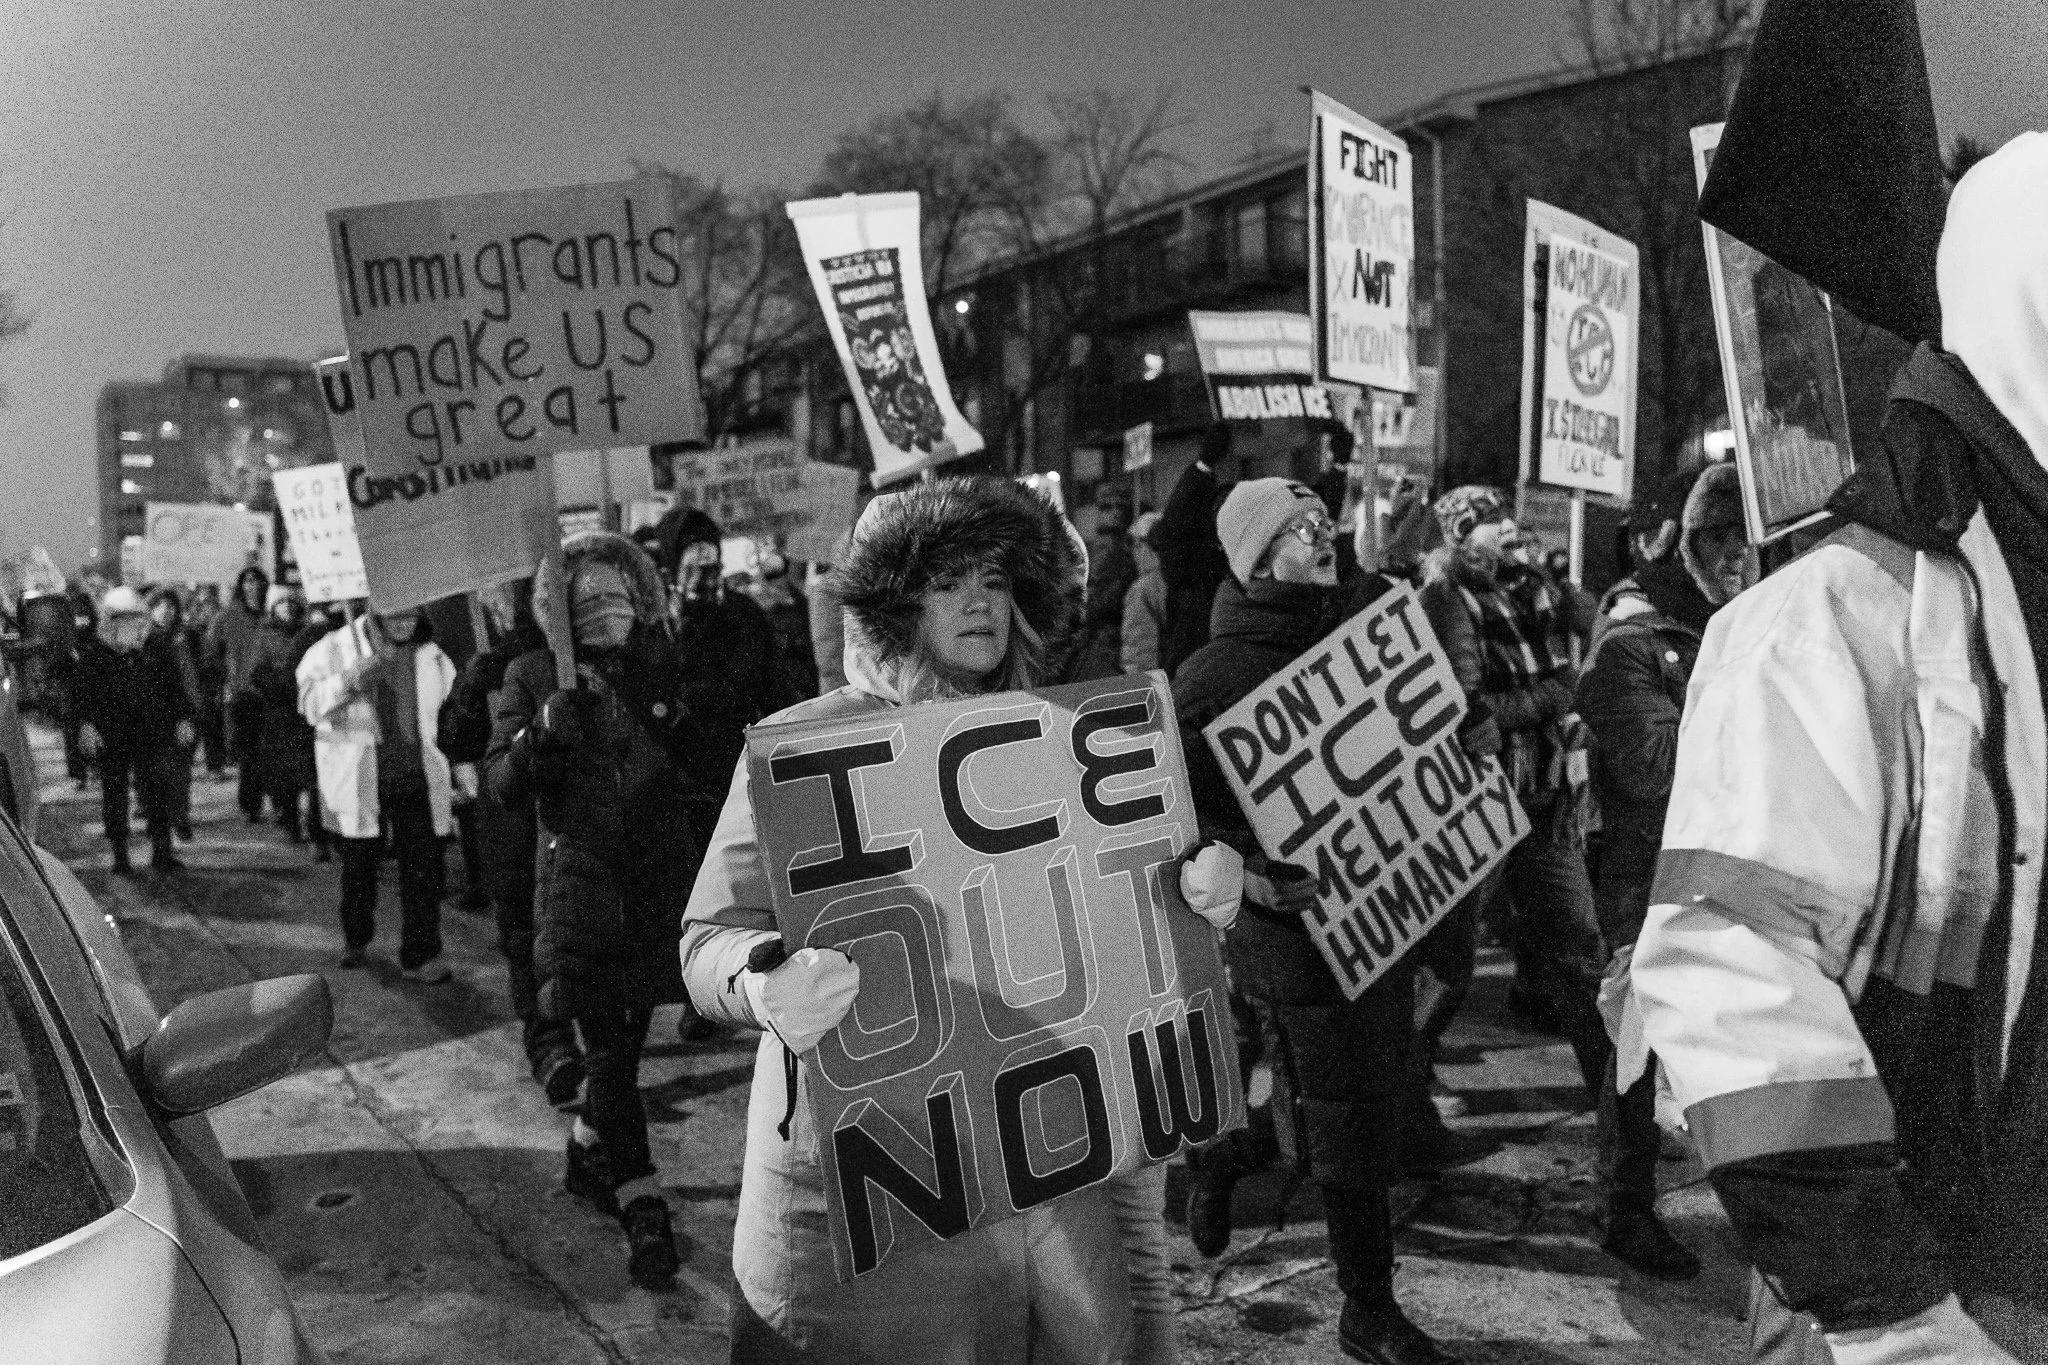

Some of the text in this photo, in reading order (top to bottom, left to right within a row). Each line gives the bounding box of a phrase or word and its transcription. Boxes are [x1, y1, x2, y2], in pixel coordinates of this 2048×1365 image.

[1340, 129, 1399, 190] FIGHT
[338, 197, 681, 322] Immigrants
[1352, 248, 1396, 308] NOT
[360, 318, 545, 400] make
[562, 301, 656, 371] US
[404, 368, 628, 467] great
[1217, 384, 1333, 420] ABOLISH ICE
[1217, 595, 1421, 787] DON'T LET
[1250, 652, 1461, 859] ICE
[769, 687, 1176, 896] ICE
[1312, 775, 1420, 928] MELT
[804, 822, 1184, 1091] OUT
[1326, 774, 1518, 988] HUMANITY
[832, 988, 1232, 1278] NOW
